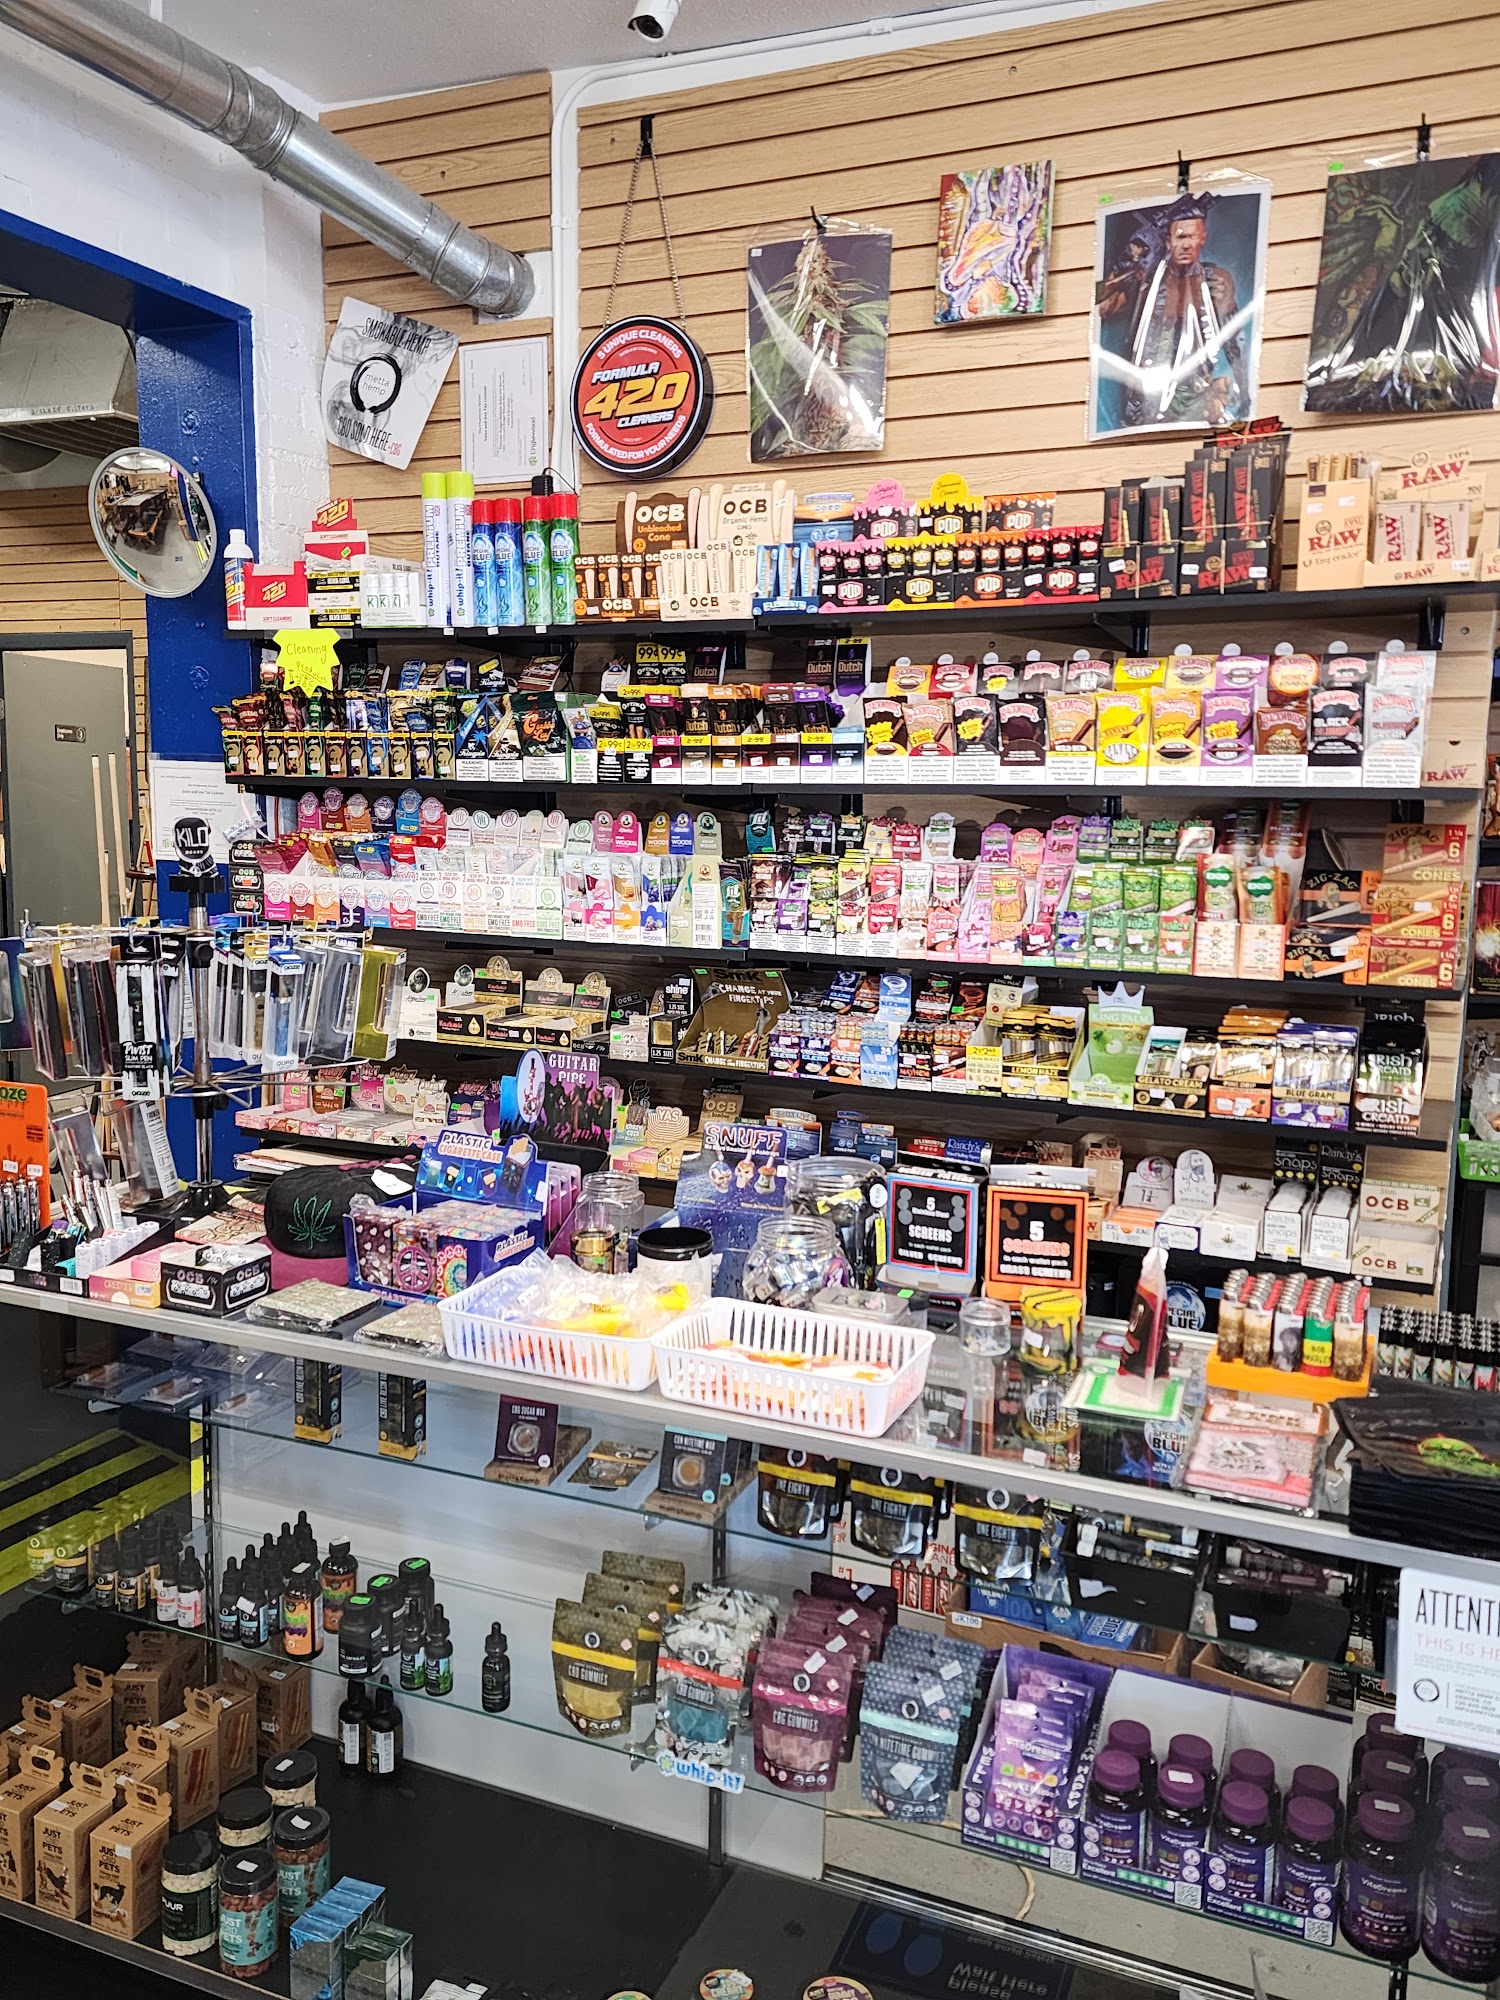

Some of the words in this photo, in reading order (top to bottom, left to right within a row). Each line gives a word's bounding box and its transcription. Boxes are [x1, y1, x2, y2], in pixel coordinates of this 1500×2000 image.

[362, 318, 406, 347] SMOKABLE
[405, 332, 431, 355] HEMP
[602, 331, 638, 353] UNIQUE
[639, 330, 683, 359] CLEANERS
[592, 361, 660, 384] FORMULA
[365, 373, 390, 387] metta
[362, 381, 386, 396] hemp
[584, 372, 690, 419] 420
[617, 410, 674, 428] CLEANERS
[586, 423, 628, 459] FORMULATED
[628, 451, 644, 459] FOR
[644, 438, 667, 456] YOUR
[666, 415, 686, 441] NEEDS
[1448, 451, 1469, 460] TIPS
[1401, 459, 1465, 490] RAW
[317, 501, 348, 526] 420
[636, 504, 685, 523] OCB
[724, 499, 767, 515] OCB
[637, 523, 681, 534] Unbleached
[723, 517, 748, 526] Organic
[750, 517, 768, 525] Hemp
[938, 518, 960, 532] POP
[1007, 515, 1030, 529] POP
[874, 523, 896, 535] POP
[648, 533, 671, 541] Cone
[1308, 528, 1362, 551] RAW
[1385, 516, 1402, 562] RAW
[1404, 566, 1435, 579] RAW
[262, 581, 286, 602] 420
[840, 586, 860, 598] POP
[602, 600, 632, 610] OCB
[690, 597, 719, 607] OCB
[601, 610, 635, 618] Unbleached
[286, 643, 326, 661] Cleaning
[660, 647, 682, 659] 99¢
[296, 661, 327, 684] Products
[694, 667, 717, 677] Dutch
[807, 663, 831, 673] Dutch
[838, 661, 863, 672] Dutch
[686, 720, 708, 731] Dutch
[1427, 768, 1468, 783] RAW
[176, 827, 209, 847] KILO
[1388, 826, 1439, 843] ZIG-ZAG
[1449, 842, 1459, 858] 6
[1308, 872, 1358, 890] ZIG-ZAG
[1413, 871, 1461, 882] CONES
[488, 918, 498, 926] GMO
[499, 918, 510, 927] FREE
[1442, 914, 1454, 930] 6
[1401, 928, 1440, 937] CONES
[1286, 946, 1330, 962] ZIG-ZAG
[1372, 950, 1416, 962] ZIG-ZAG
[713, 968, 762, 982] Smk
[1439, 964, 1452, 982] 6
[719, 983, 756, 994] CHANGE
[1397, 976, 1437, 987] CONES
[666, 984, 688, 994] shine
[439, 1019, 463, 1030] Kashmir
[123, 1042, 153, 1055] TWIST
[549, 1053, 597, 1072] GUITAR
[678, 1052, 704, 1062] Smk
[704, 1056, 727, 1066] CHANGE
[558, 1071, 586, 1084] PIPE
[1011, 1067, 1038, 1076] LEMON
[1039, 1069, 1060, 1077] HAZE
[1286, 1089, 1307, 1098] BLUE
[1311, 1090, 1337, 1100] GRAPE
[705, 1100, 737, 1113] OCB
[658, 1108, 679, 1122] YAS
[443, 1133, 491, 1149] PLASTIC
[706, 1125, 783, 1150] SNUFF
[947, 1137, 980, 1151] Randy's
[439, 1143, 481, 1158] CIGARETTE
[481, 1151, 502, 1162] CASE
[1321, 1145, 1362, 1161] Randy's
[1275, 1158, 1317, 1170] snaps
[1321, 1172, 1360, 1183] snaps
[1380, 1188, 1397, 1196] Slim
[927, 1197, 936, 1211] 5
[1366, 1196, 1409, 1210] OCB
[1367, 1209, 1388, 1217] Organic
[908, 1224, 952, 1243] SCREENS
[1030, 1220, 1045, 1241] 5
[1267, 1229, 1297, 1239] snaps
[497, 1231, 527, 1251] PLASTIC
[1314, 1233, 1344, 1245] snaps
[1003, 1237, 1070, 1257] SCREENS
[1362, 1257, 1397, 1269] OCB
[1167, 1308, 1196, 1318] PECIAL
[1168, 1318, 1198, 1330] LUE
[776, 1479, 787, 1491] ONE
[788, 1481, 811, 1497] EIGHTH
[872, 1498, 882, 1511] ONE
[883, 1500, 908, 1517] EIGHTH
[976, 1522, 986, 1535] ONE
[987, 1524, 1016, 1541] EIGHTH
[1416, 1633, 1454, 1652] THIS
[1460, 1642, 1475, 1657] IS
[568, 1665, 579, 1679] CBD
[580, 1668, 609, 1687] GUMMIES
[687, 1684, 714, 1705] GUMMIES
[773, 1711, 786, 1724] CBG
[787, 1713, 818, 1733] GUMMIES
[912, 1744, 946, 1762] GUMMIES
[972, 1746, 996, 1785] WELL
[676, 1762, 741, 1791] whip-it!
[1066, 1765, 1089, 1809] HAPPY
[120, 1818, 143, 1827] JUST
[42, 1827, 61, 1839] JUST
[109, 1826, 132, 1837] PETS
[964, 1827, 995, 1842] Excellent
[43, 1842, 62, 1854] PETS
[98, 1860, 120, 1873] PETS
[1082, 1863, 1116, 1877] Excellent
[277, 1870, 301, 1881] JUST
[1361, 1878, 1408, 1894] VitaDreamz
[1207, 1895, 1242, 1913] Excellent
[220, 1915, 241, 1928] JUST
